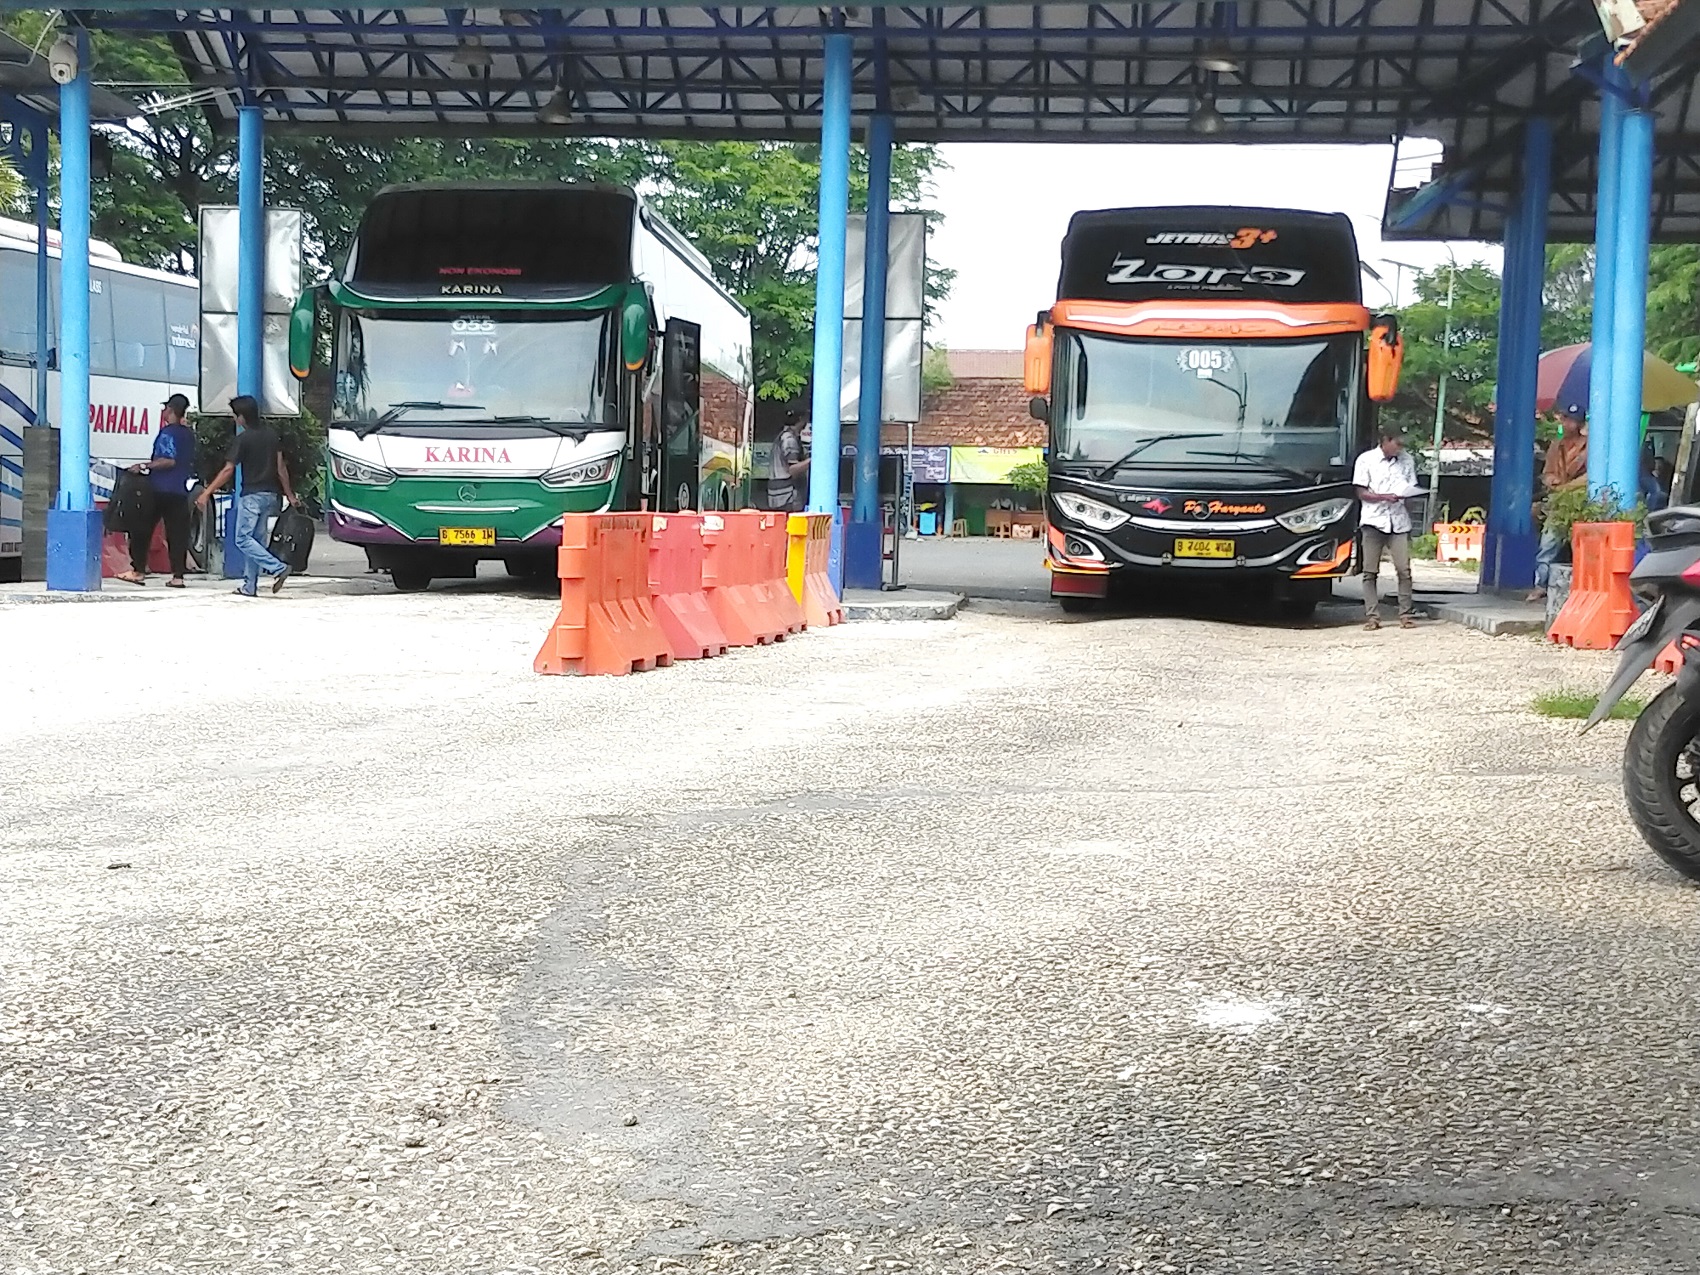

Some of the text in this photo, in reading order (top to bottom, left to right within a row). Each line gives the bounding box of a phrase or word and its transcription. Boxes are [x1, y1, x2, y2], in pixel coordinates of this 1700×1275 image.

[441, 285, 502, 295] KARINA
[1188, 350, 1222, 369] 005
[424, 446, 512, 464] KARINA
[442, 530, 448, 539] B
